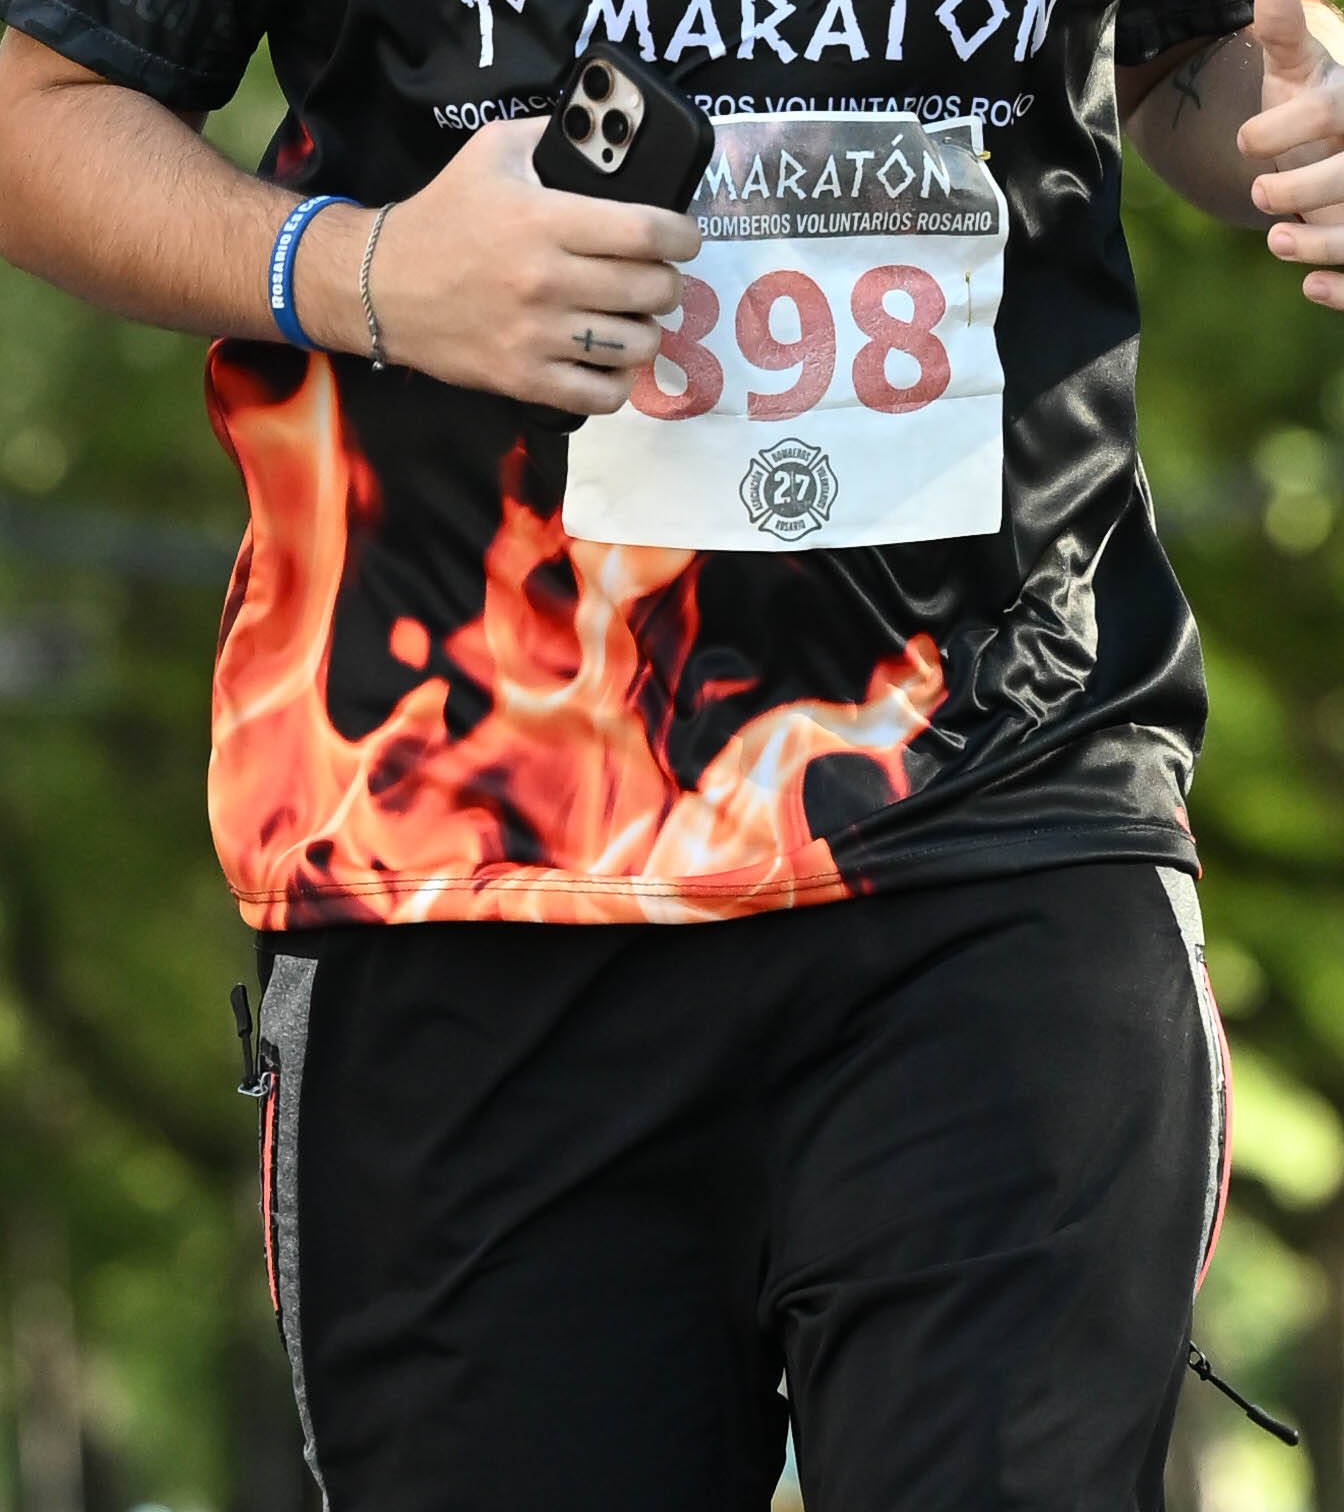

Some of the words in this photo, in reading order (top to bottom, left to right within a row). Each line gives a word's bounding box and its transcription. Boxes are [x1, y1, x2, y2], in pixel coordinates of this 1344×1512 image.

[687, 94, 755, 117] ROS
[692, 134, 951, 202] MARATÓN
[697, 214, 790, 236] BOMBEROS
[796, 212, 912, 234] VOLUNTARIOS
[916, 211, 992, 232] ROSARIO
[272, 233, 292, 309] ROSARIO
[629, 264, 952, 422] 898
[774, 471, 810, 505] 27
